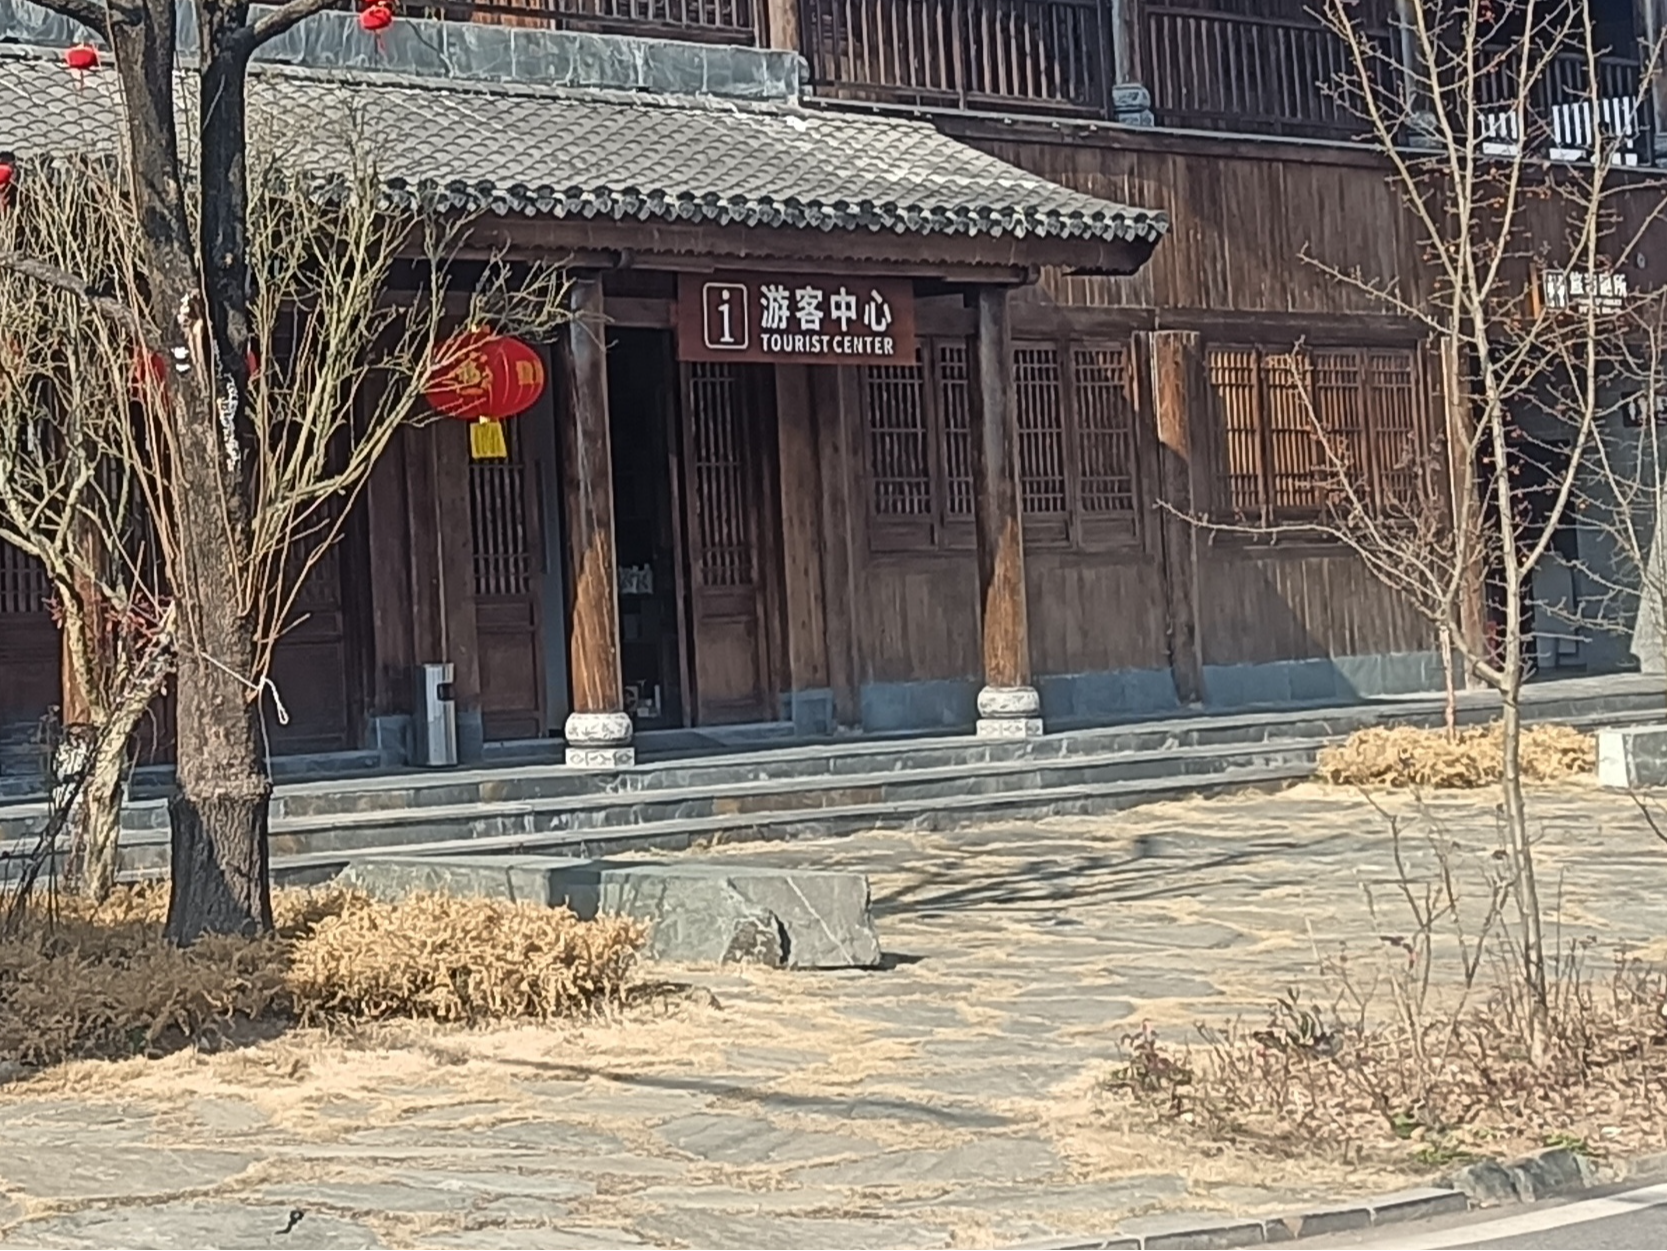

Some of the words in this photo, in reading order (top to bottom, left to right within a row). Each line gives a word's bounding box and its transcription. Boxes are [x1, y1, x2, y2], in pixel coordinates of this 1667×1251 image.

[760, 284, 892, 332] 游客中心
[760, 333, 830, 353] TOURIST
[833, 334, 894, 355] CENTER
